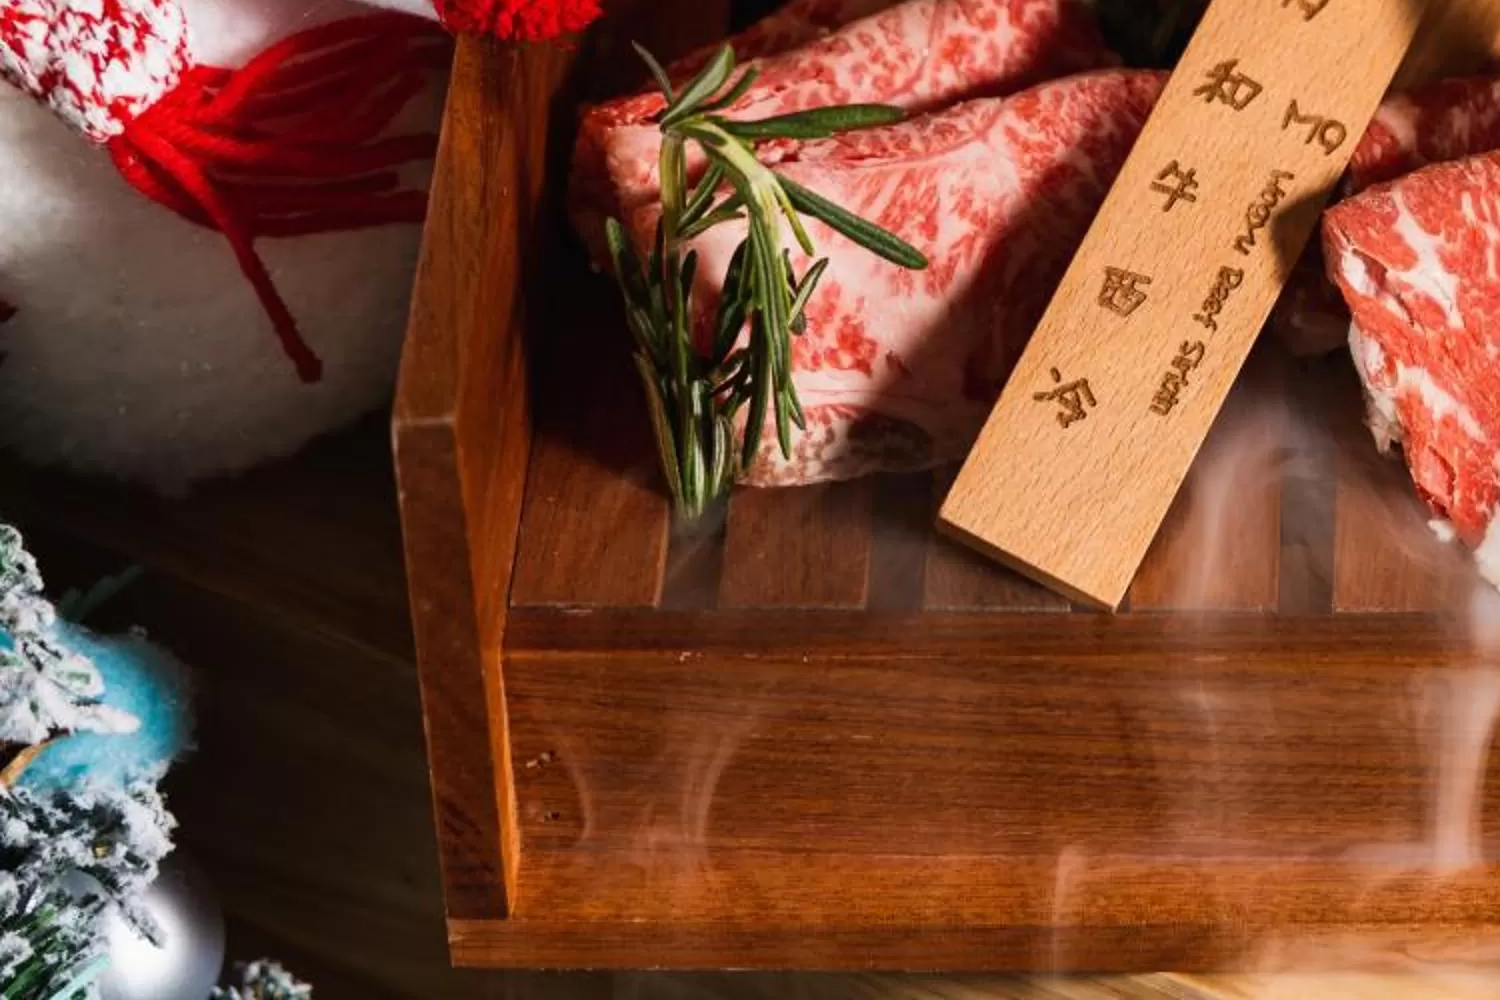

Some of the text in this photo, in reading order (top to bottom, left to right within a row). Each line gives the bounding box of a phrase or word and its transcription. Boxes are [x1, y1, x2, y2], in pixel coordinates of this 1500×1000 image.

[1281, 99, 1347, 155] M9
[1232, 168, 1295, 256] Wagyu
[1193, 265, 1244, 333] Beef
